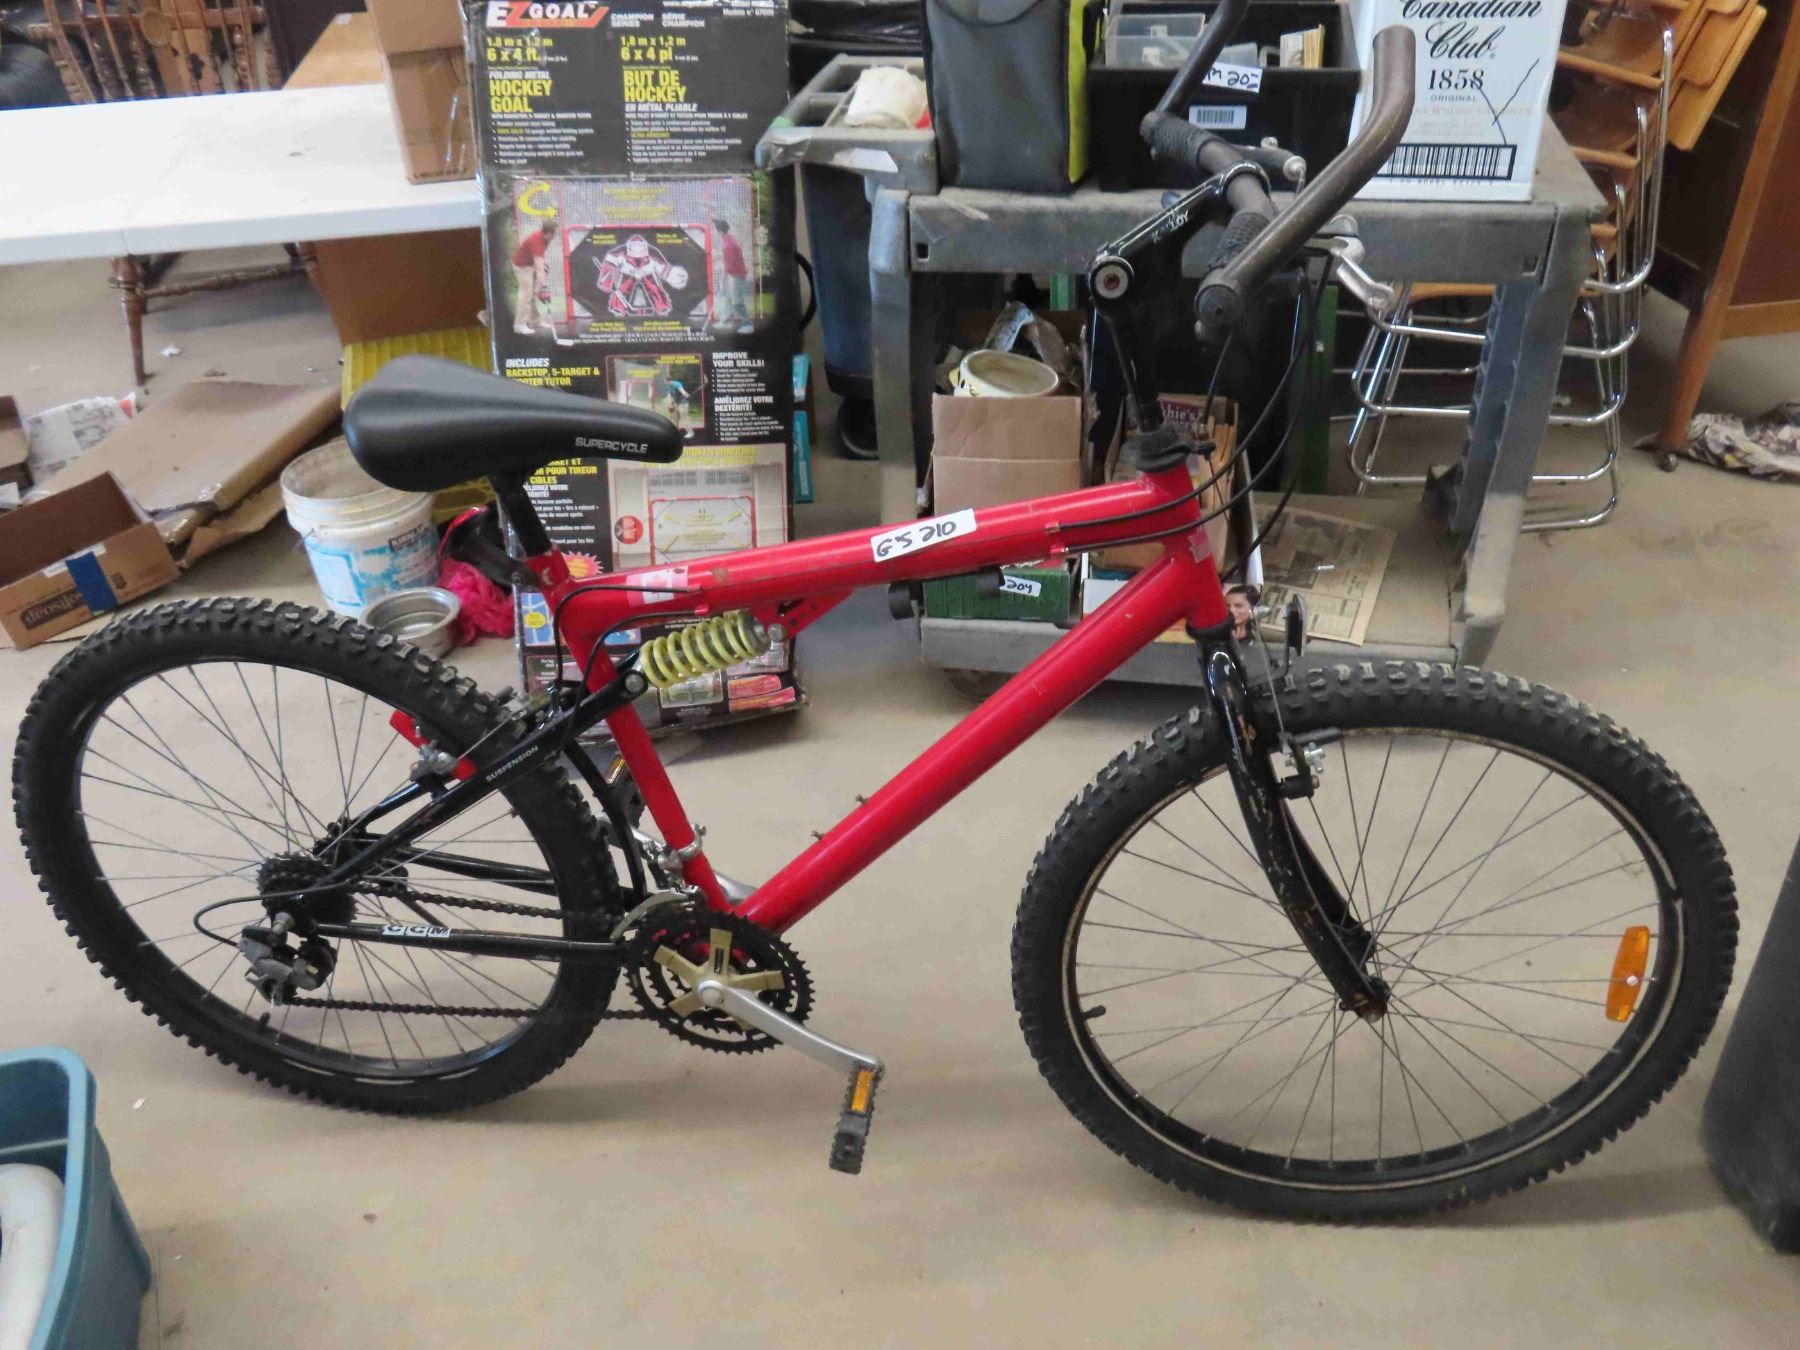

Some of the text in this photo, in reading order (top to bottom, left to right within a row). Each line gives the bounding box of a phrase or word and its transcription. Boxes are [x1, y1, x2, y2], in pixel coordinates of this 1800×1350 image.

[529, 3, 589, 19] GOAL
[487, 48, 497, 61] 6
[513, 48, 522, 61] 4
[621, 47, 631, 61] 6
[646, 47, 656, 60] 4
[624, 70, 679, 86] BUT DE
[1428, 68, 1485, 91] 1858
[489, 80, 552, 96] HOCKEY
[625, 86, 687, 102] HOCKEY
[491, 96, 533, 113] GOAL
[505, 358, 549, 368] INCLUDES
[712, 352, 748, 360] IMPROVE
[712, 360, 734, 368] YOUR
[545, 377, 572, 386] TUTOR
[575, 437, 649, 454] SUPERCYCLE
[919, 521, 956, 542] 210
[486, 746, 539, 782] SUSPENSION
